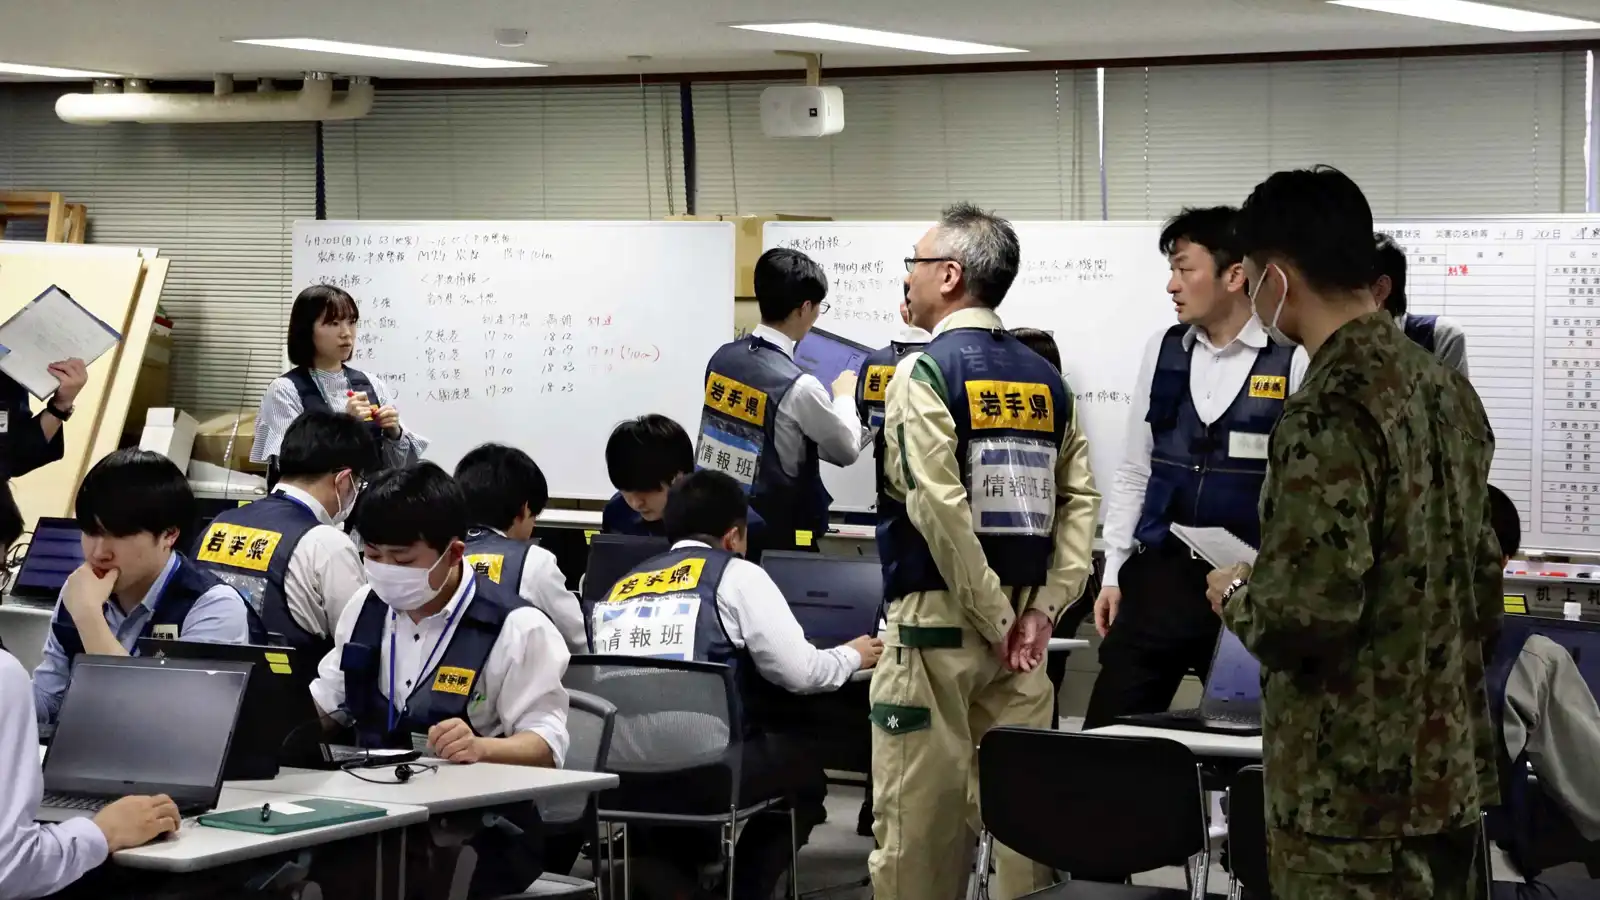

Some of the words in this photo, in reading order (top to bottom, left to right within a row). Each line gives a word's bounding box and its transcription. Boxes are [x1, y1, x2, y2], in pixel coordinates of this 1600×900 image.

[710, 380, 760, 418] 岩手県
[980, 390, 1049, 421] 岩手県
[700, 441, 754, 478] 情報班
[982, 474, 1050, 500] 情報班長
[207, 530, 269, 560] 岩手県
[618, 564, 692, 596] 岩手県
[603, 623, 685, 652] 情報班
[437, 672, 469, 686] 岩手県
